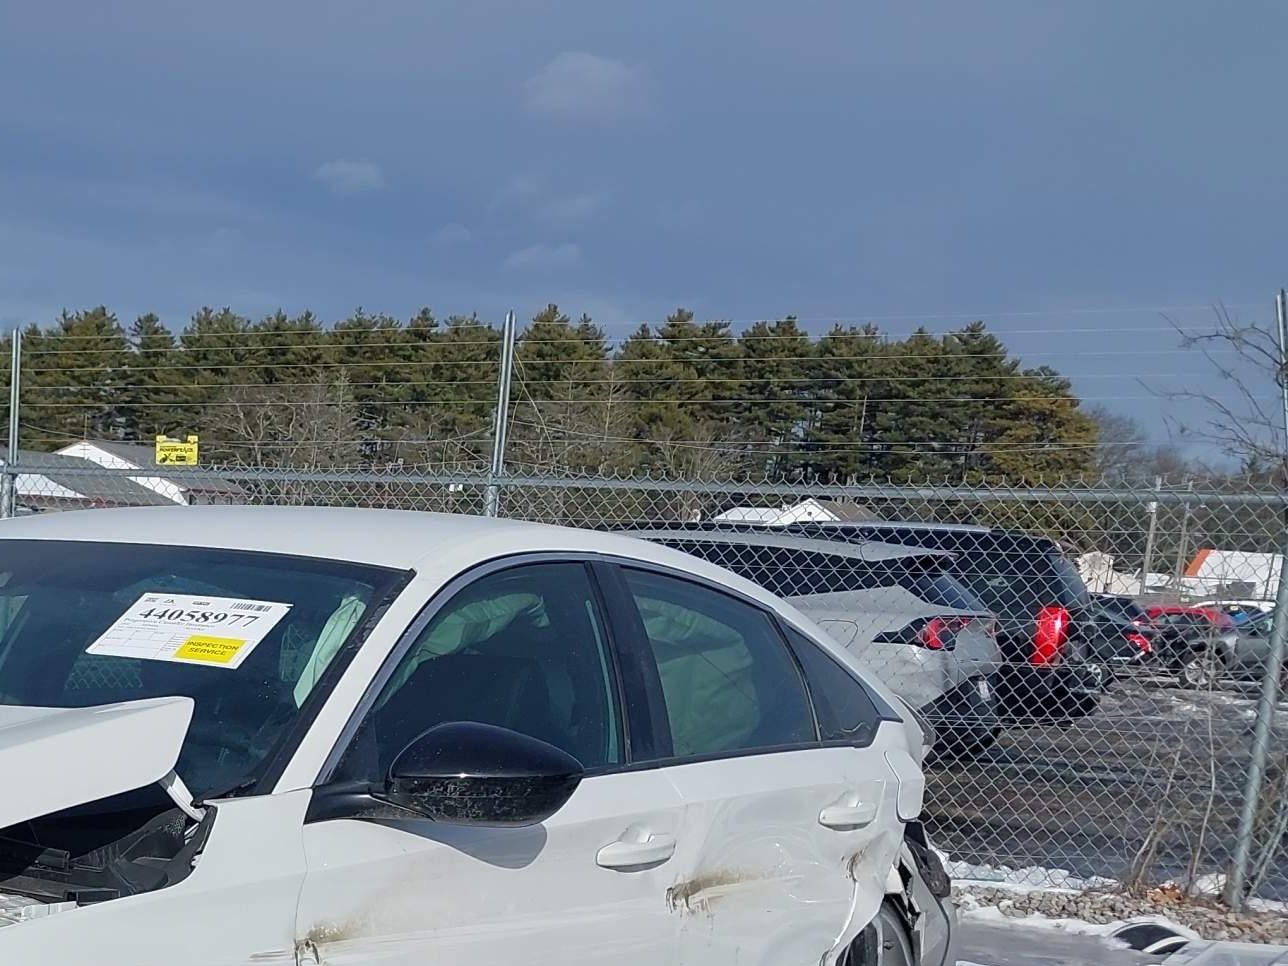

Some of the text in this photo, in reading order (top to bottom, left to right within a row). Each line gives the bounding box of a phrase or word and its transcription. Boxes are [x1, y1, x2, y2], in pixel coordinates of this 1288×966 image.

[139, 607, 260, 627] 44058977
[187, 640, 240, 651] INSPECTION
[188, 647, 228, 656] SERVICE
